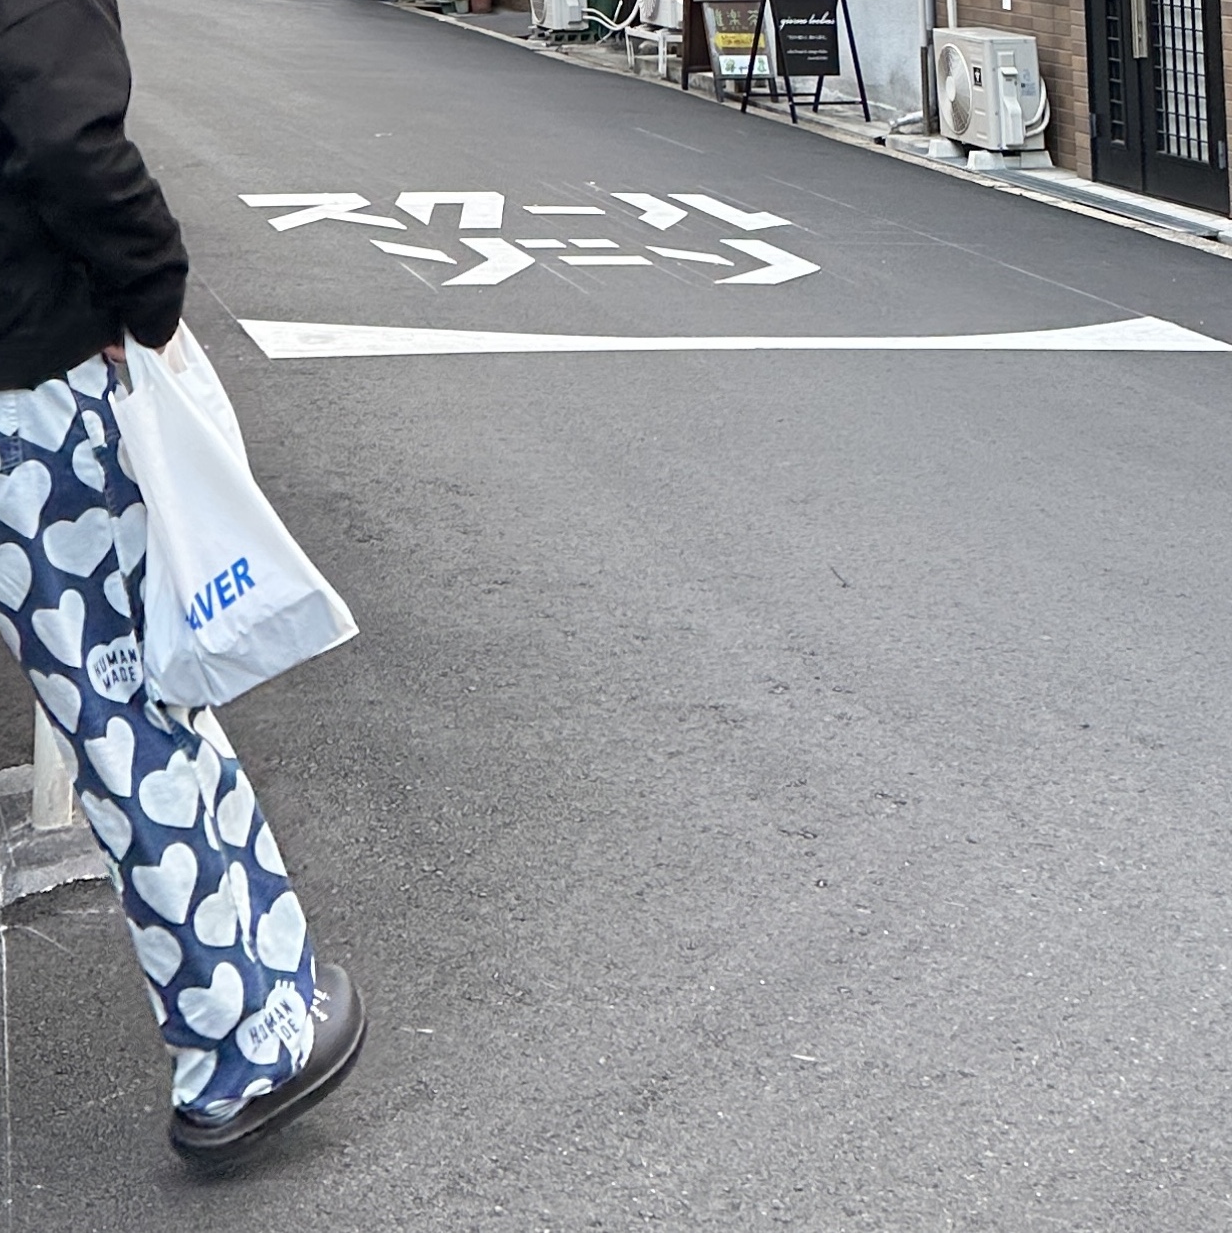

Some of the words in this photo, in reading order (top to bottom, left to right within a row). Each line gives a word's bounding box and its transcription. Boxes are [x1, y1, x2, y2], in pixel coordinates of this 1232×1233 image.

[237, 191, 792, 232] スクール
[369, 237, 821, 286] ゾーン
